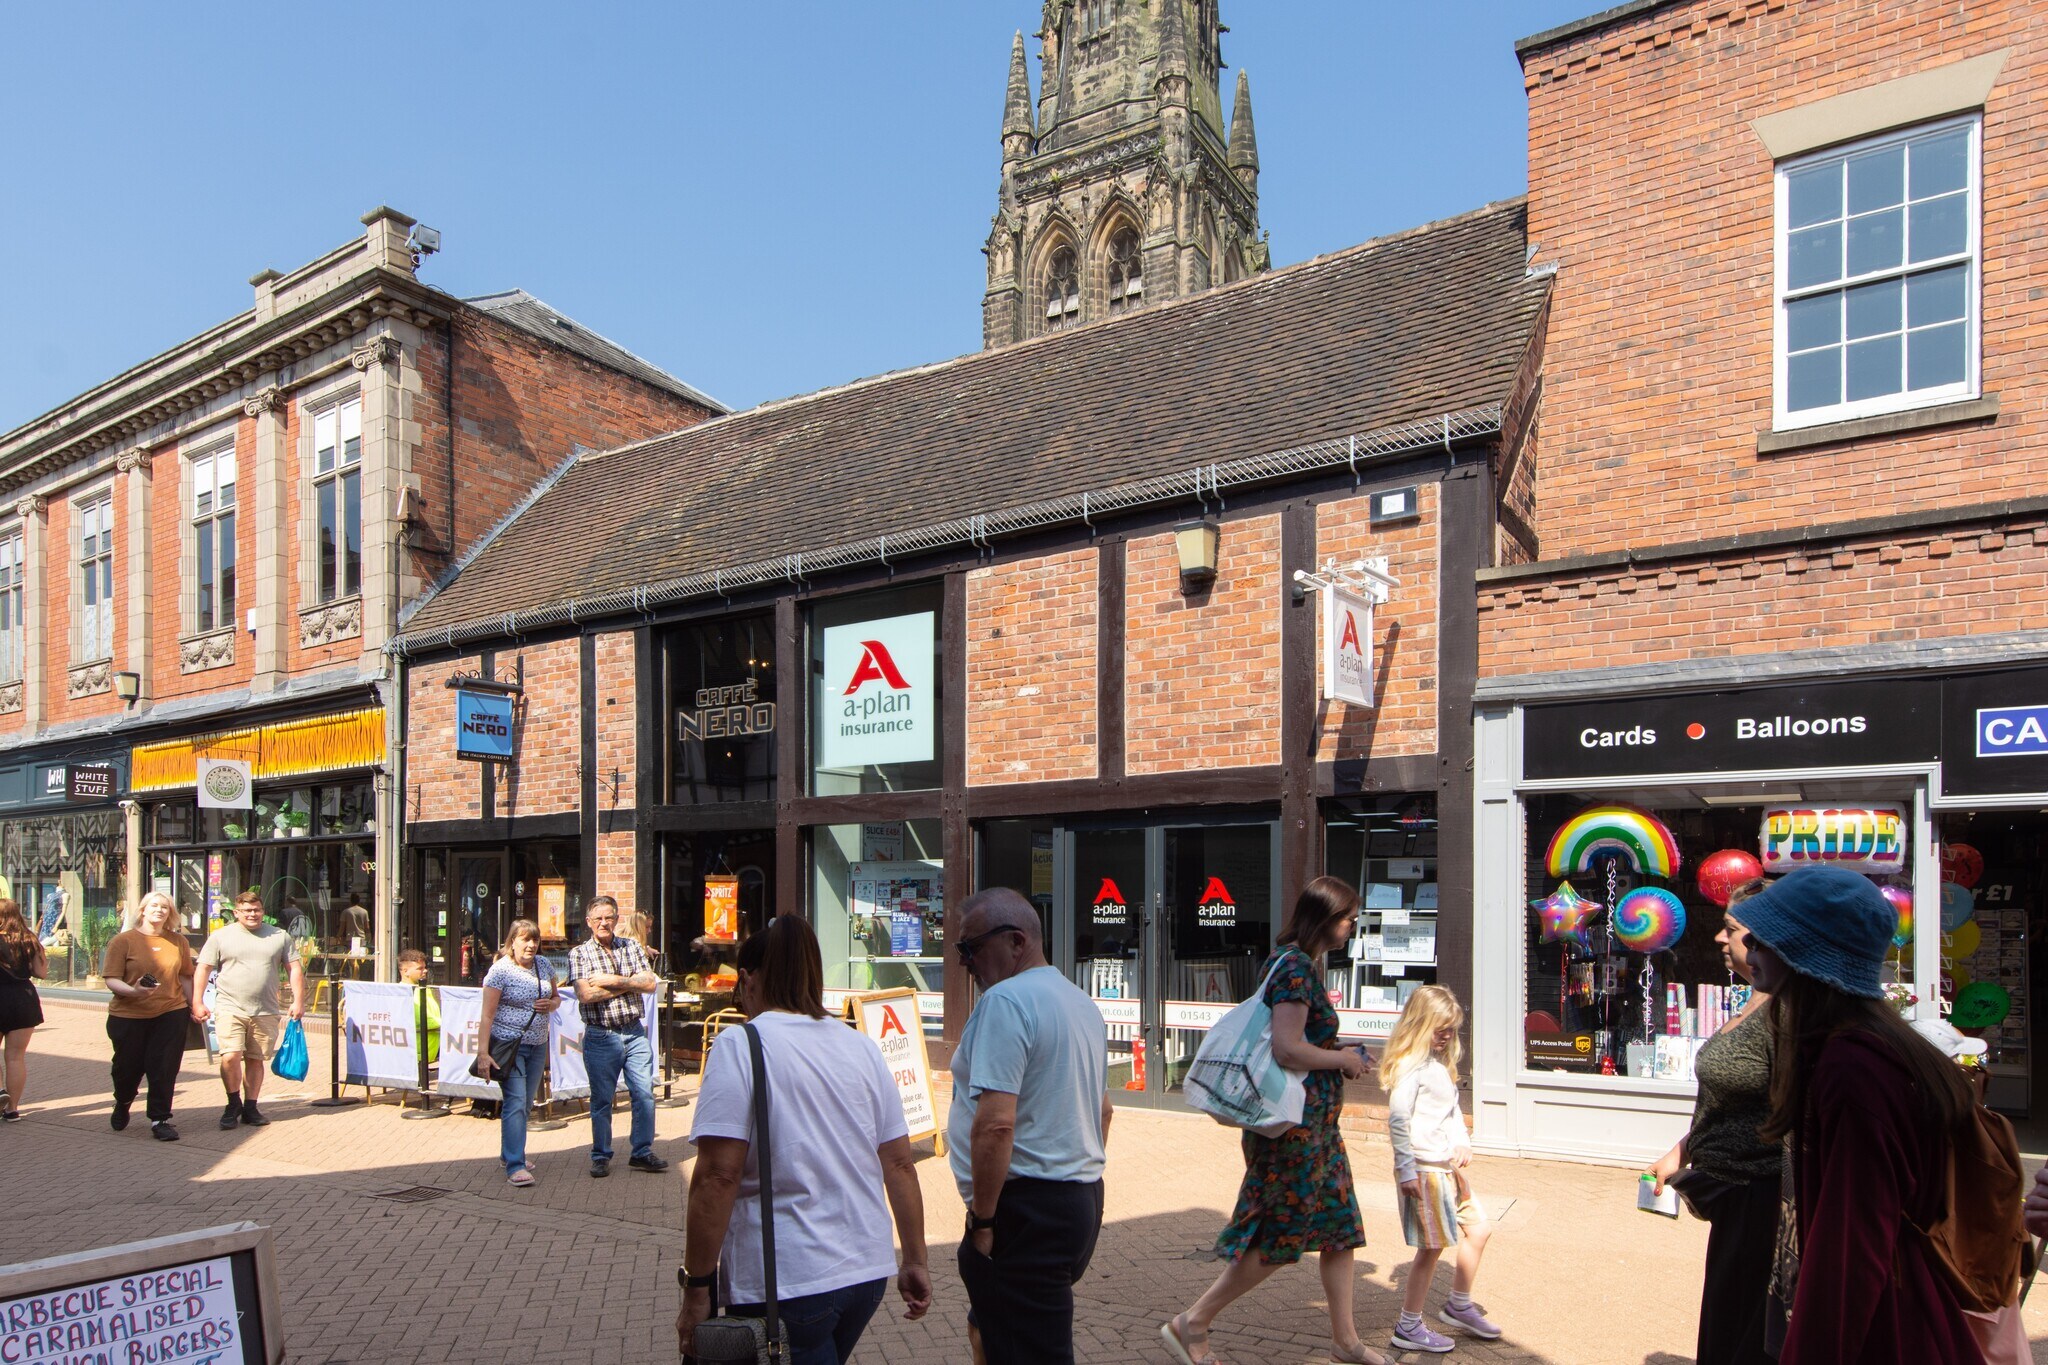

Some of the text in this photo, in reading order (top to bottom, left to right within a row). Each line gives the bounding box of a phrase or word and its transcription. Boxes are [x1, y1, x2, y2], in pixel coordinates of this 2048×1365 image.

[1339, 653, 1363, 674] a-plan
[1339, 673, 1363, 686] insurance
[695, 677, 759, 708] CAFFÈ
[843, 690, 911, 720] a-plan
[471, 713, 500, 723] CAFFÈ
[678, 702, 777, 741] NERO
[463, 721, 508, 737] NERO
[840, 718, 914, 737] insurance
[1580, 715, 1867, 748] Cards Balloons
[47, 768, 66, 788] WHI
[75, 771, 109, 782] WHITE
[75, 784, 109, 794] STUFF
[866, 826, 885, 835] SLICE
[1766, 808, 1900, 862] PRIDE
[1033, 853, 1053, 864] Actio
[361, 862, 377, 875] ope
[711, 887, 732, 898] SPRITZ
[1710, 879, 1738, 895] Prde
[1986, 884, 2013, 901] £1
[1093, 903, 1126, 916] a-plan
[1198, 903, 1236, 918] a-plan
[922, 999, 943, 1009] travel
[1101, 1007, 1135, 1017] an.co.uk
[1180, 1011, 1211, 1021] 01543
[1357, 1018, 1396, 1030] conten
[352, 1022, 409, 1048] NERO
[446, 1031, 479, 1055] NE
[881, 1036, 909, 1054] a-plan
[1577, 1041, 1590, 1050] ups
[885, 1052, 911, 1064] nsurance
[894, 1068, 917, 1088] PEN
[908, 1114, 932, 1127] insurance
[0, 1265, 223, 1334] RBECUE SPECIAL
[1, 1294, 205, 1364] CARAMALISED
